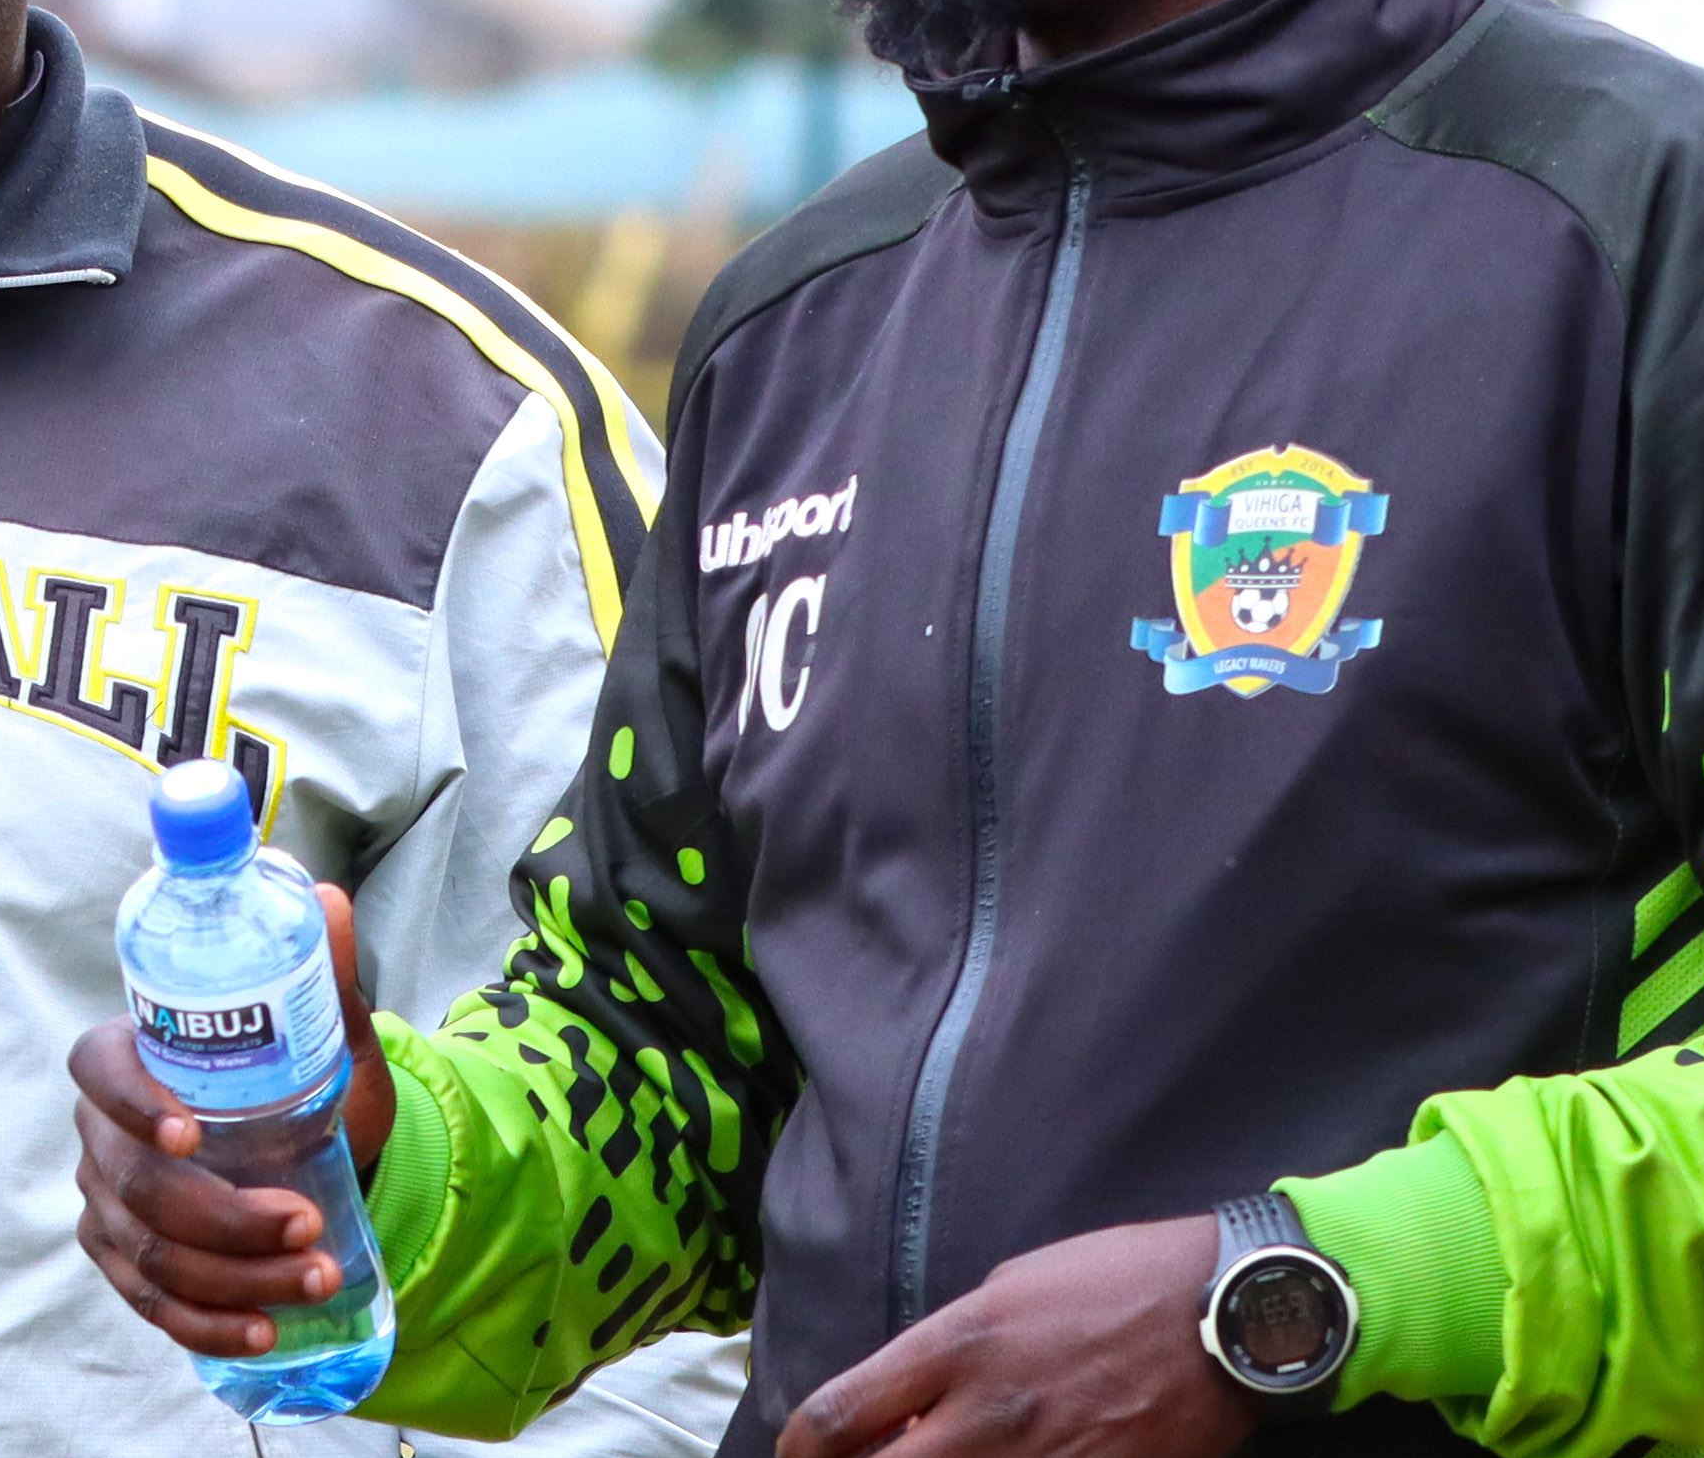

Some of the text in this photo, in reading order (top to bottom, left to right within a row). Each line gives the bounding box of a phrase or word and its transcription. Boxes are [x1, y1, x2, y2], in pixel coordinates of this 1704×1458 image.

[1299, 458, 1336, 480] 2014
[1244, 494, 1303, 514] VIHIGA
[1233, 517, 1310, 529] QUEENS FC
[136, 996, 264, 1040] NAIBUJ
[214, 1056, 252, 1069] Water
